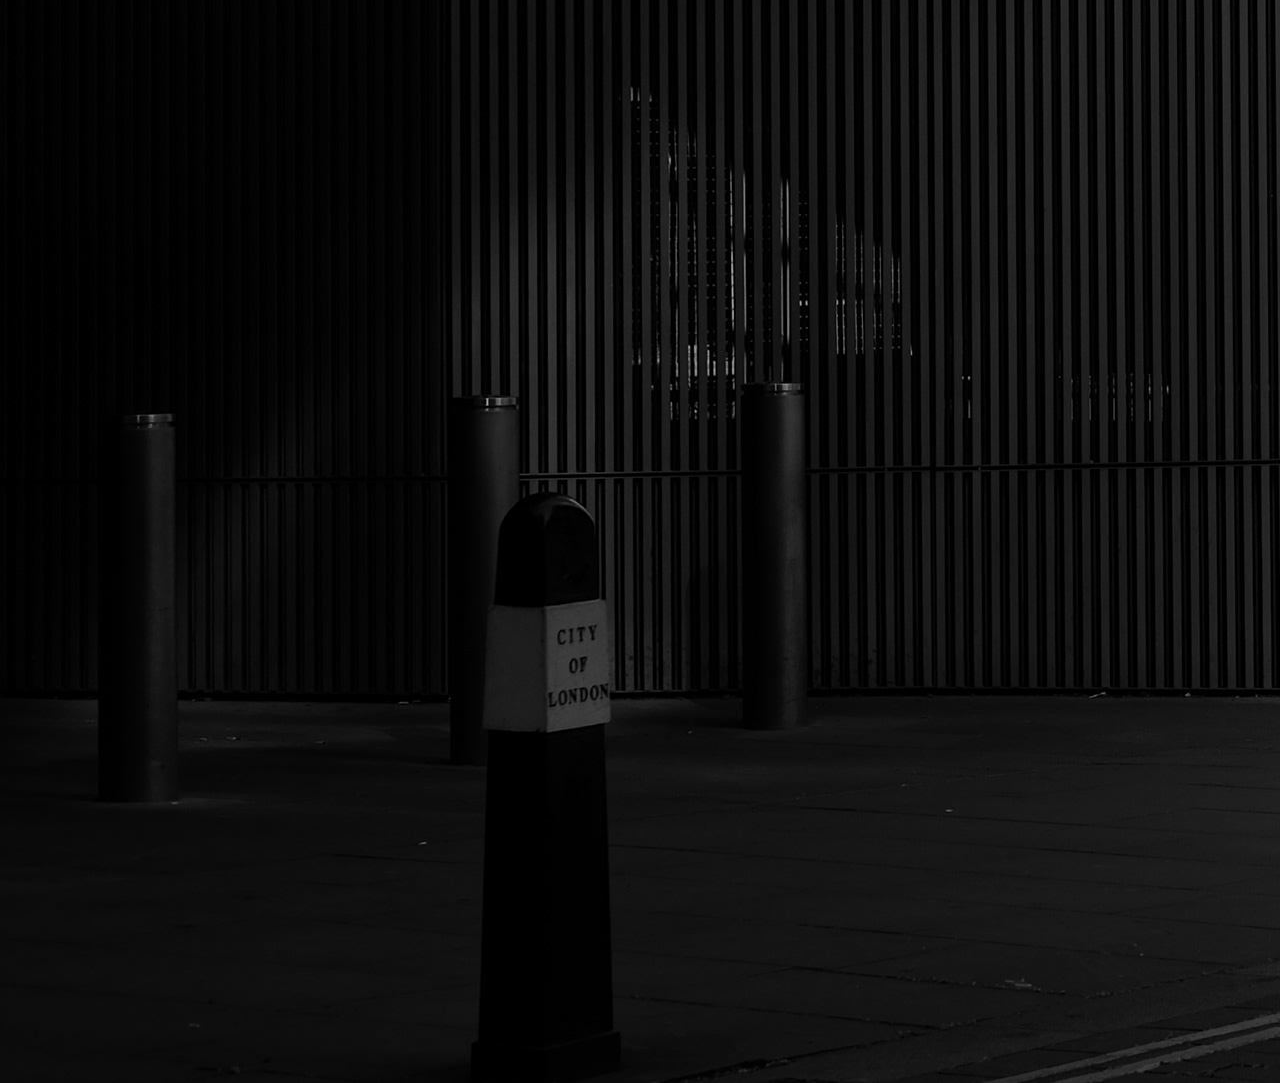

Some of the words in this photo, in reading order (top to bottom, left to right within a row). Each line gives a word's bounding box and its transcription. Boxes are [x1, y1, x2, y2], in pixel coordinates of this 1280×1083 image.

[557, 624, 598, 645] CITY
[569, 656, 588, 674] OF
[548, 683, 609, 707] LONDON
